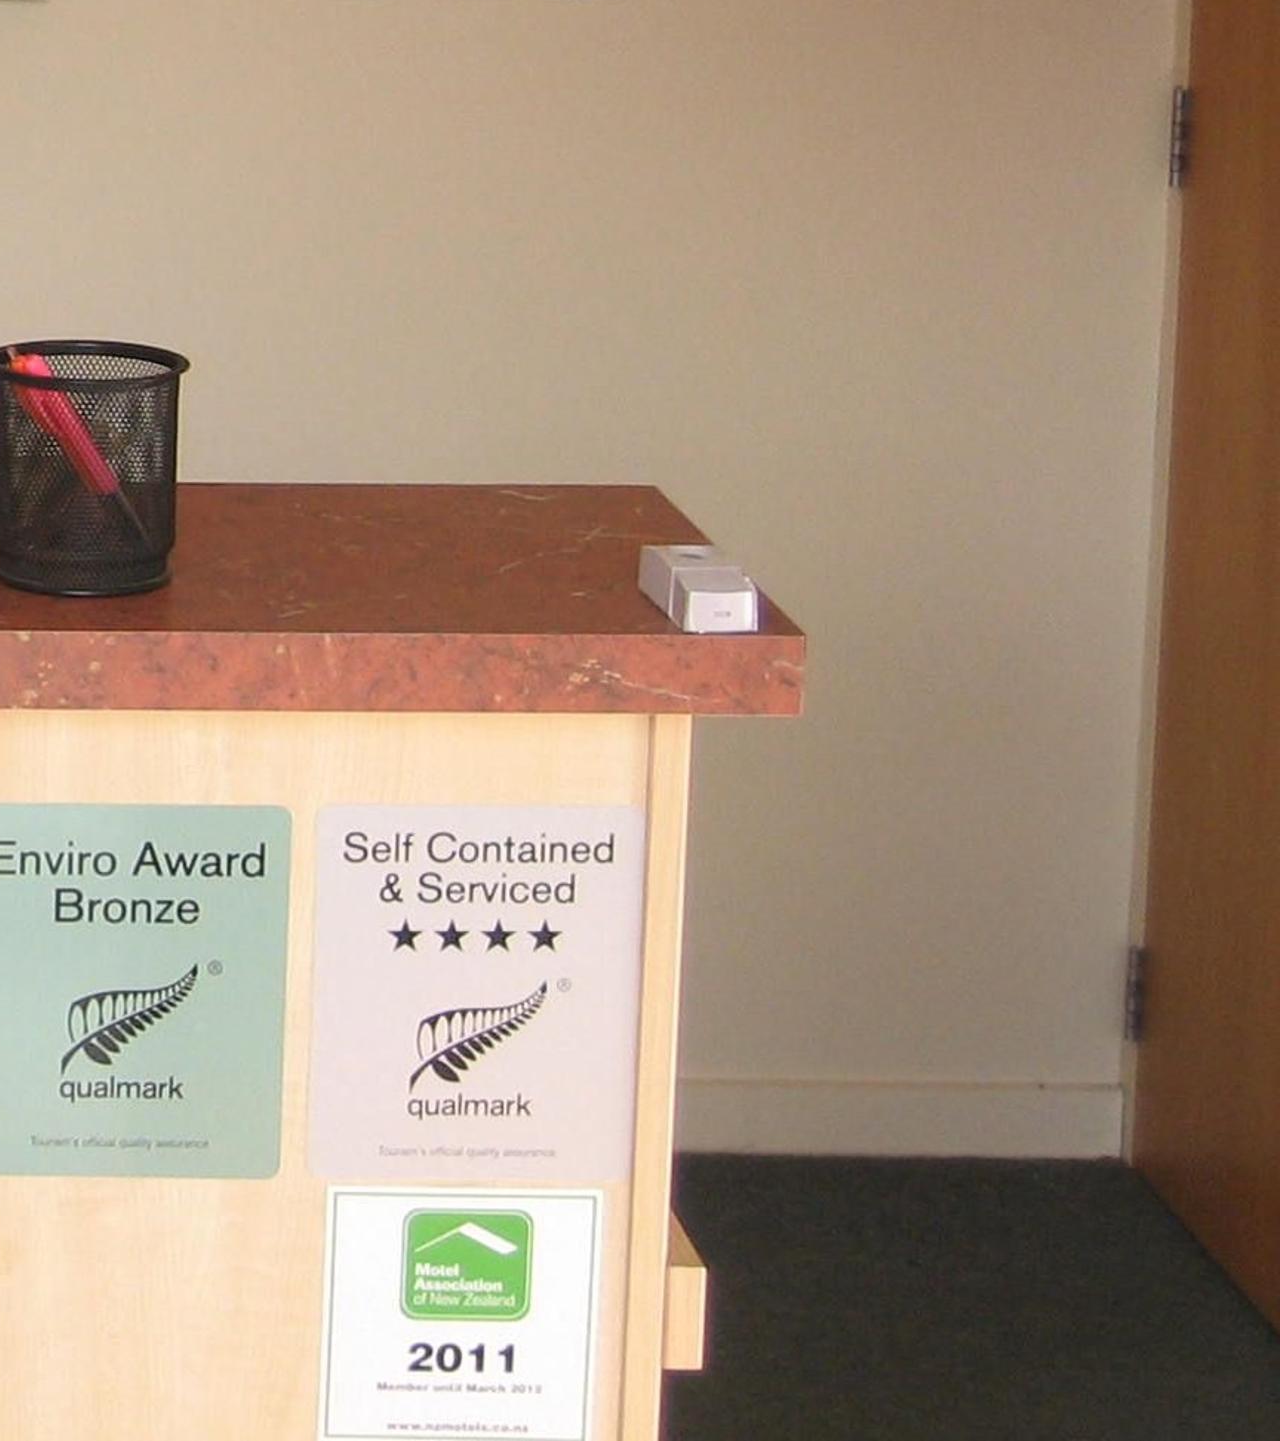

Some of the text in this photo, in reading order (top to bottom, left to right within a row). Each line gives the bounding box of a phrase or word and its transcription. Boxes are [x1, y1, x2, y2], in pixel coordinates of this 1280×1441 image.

[133, 840, 268, 878] Award
[342, 829, 615, 866] Self Contained
[379, 872, 577, 906] & Serviced
[53, 888, 200, 926] Bronze
[59, 1075, 184, 1103] qualmark
[407, 1092, 532, 1121] qualmark
[415, 1262, 460, 1276] Motel
[413, 1277, 504, 1292] Association
[406, 1341, 517, 1373] 2011
[376, 1381, 428, 1392] Member
[466, 1383, 507, 1394] March
